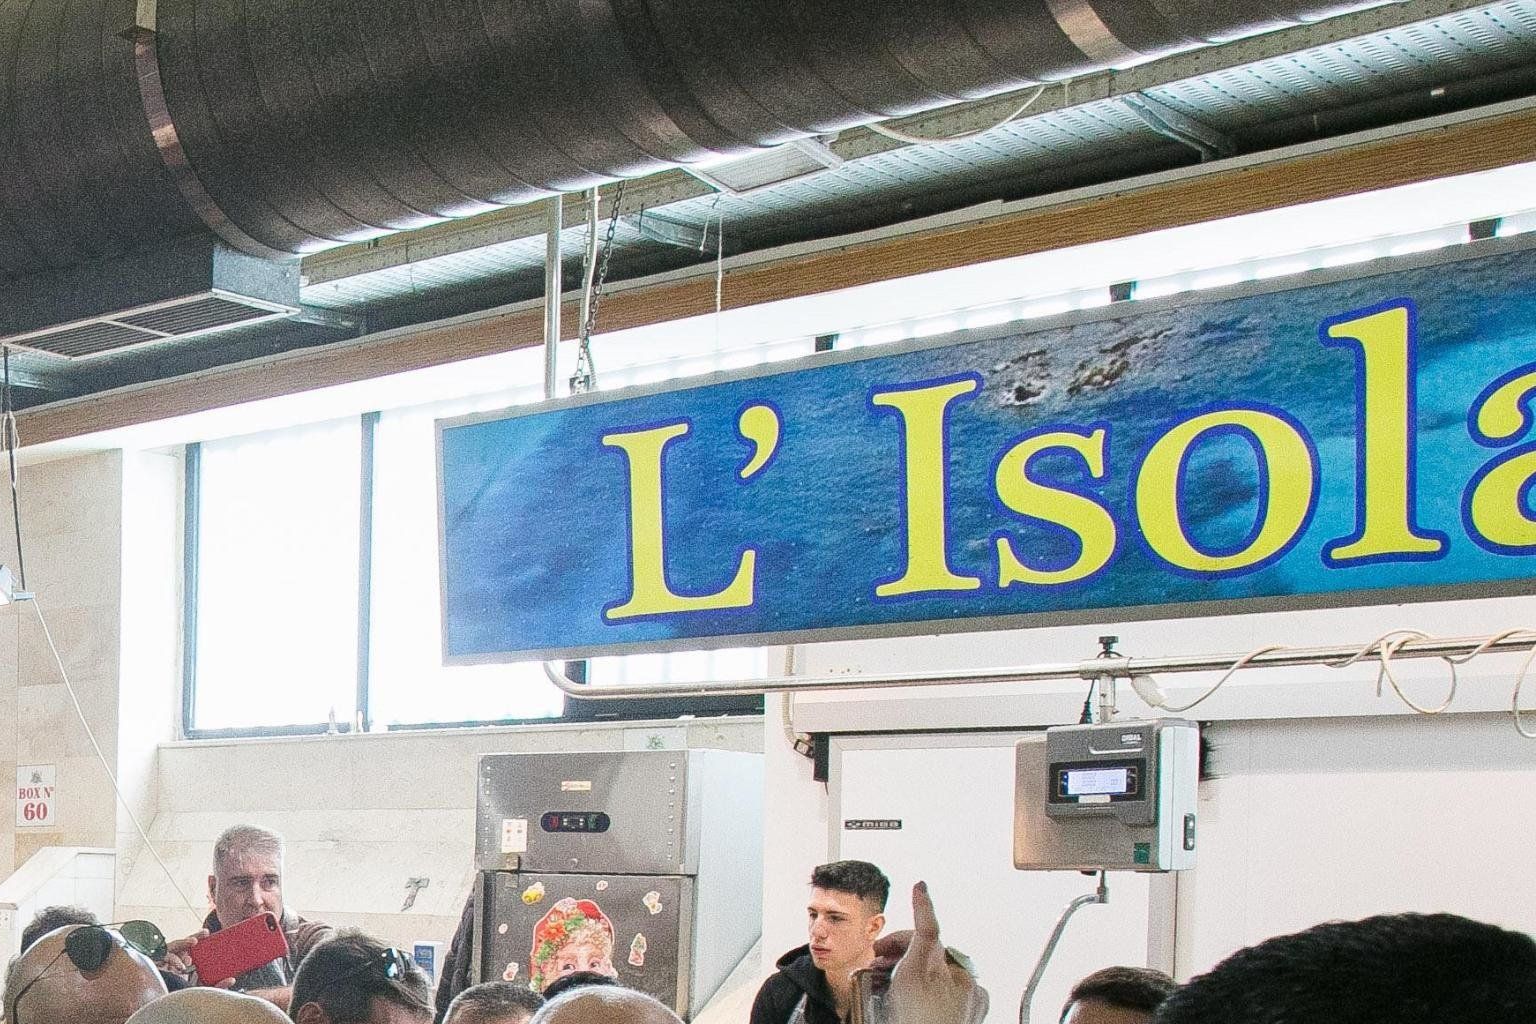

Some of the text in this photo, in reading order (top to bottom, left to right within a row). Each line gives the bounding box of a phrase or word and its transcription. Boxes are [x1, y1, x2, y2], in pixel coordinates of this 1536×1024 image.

[602, 404, 782, 622] L'
[19, 787, 40, 799] BOX
[23, 802, 48, 821] 60
